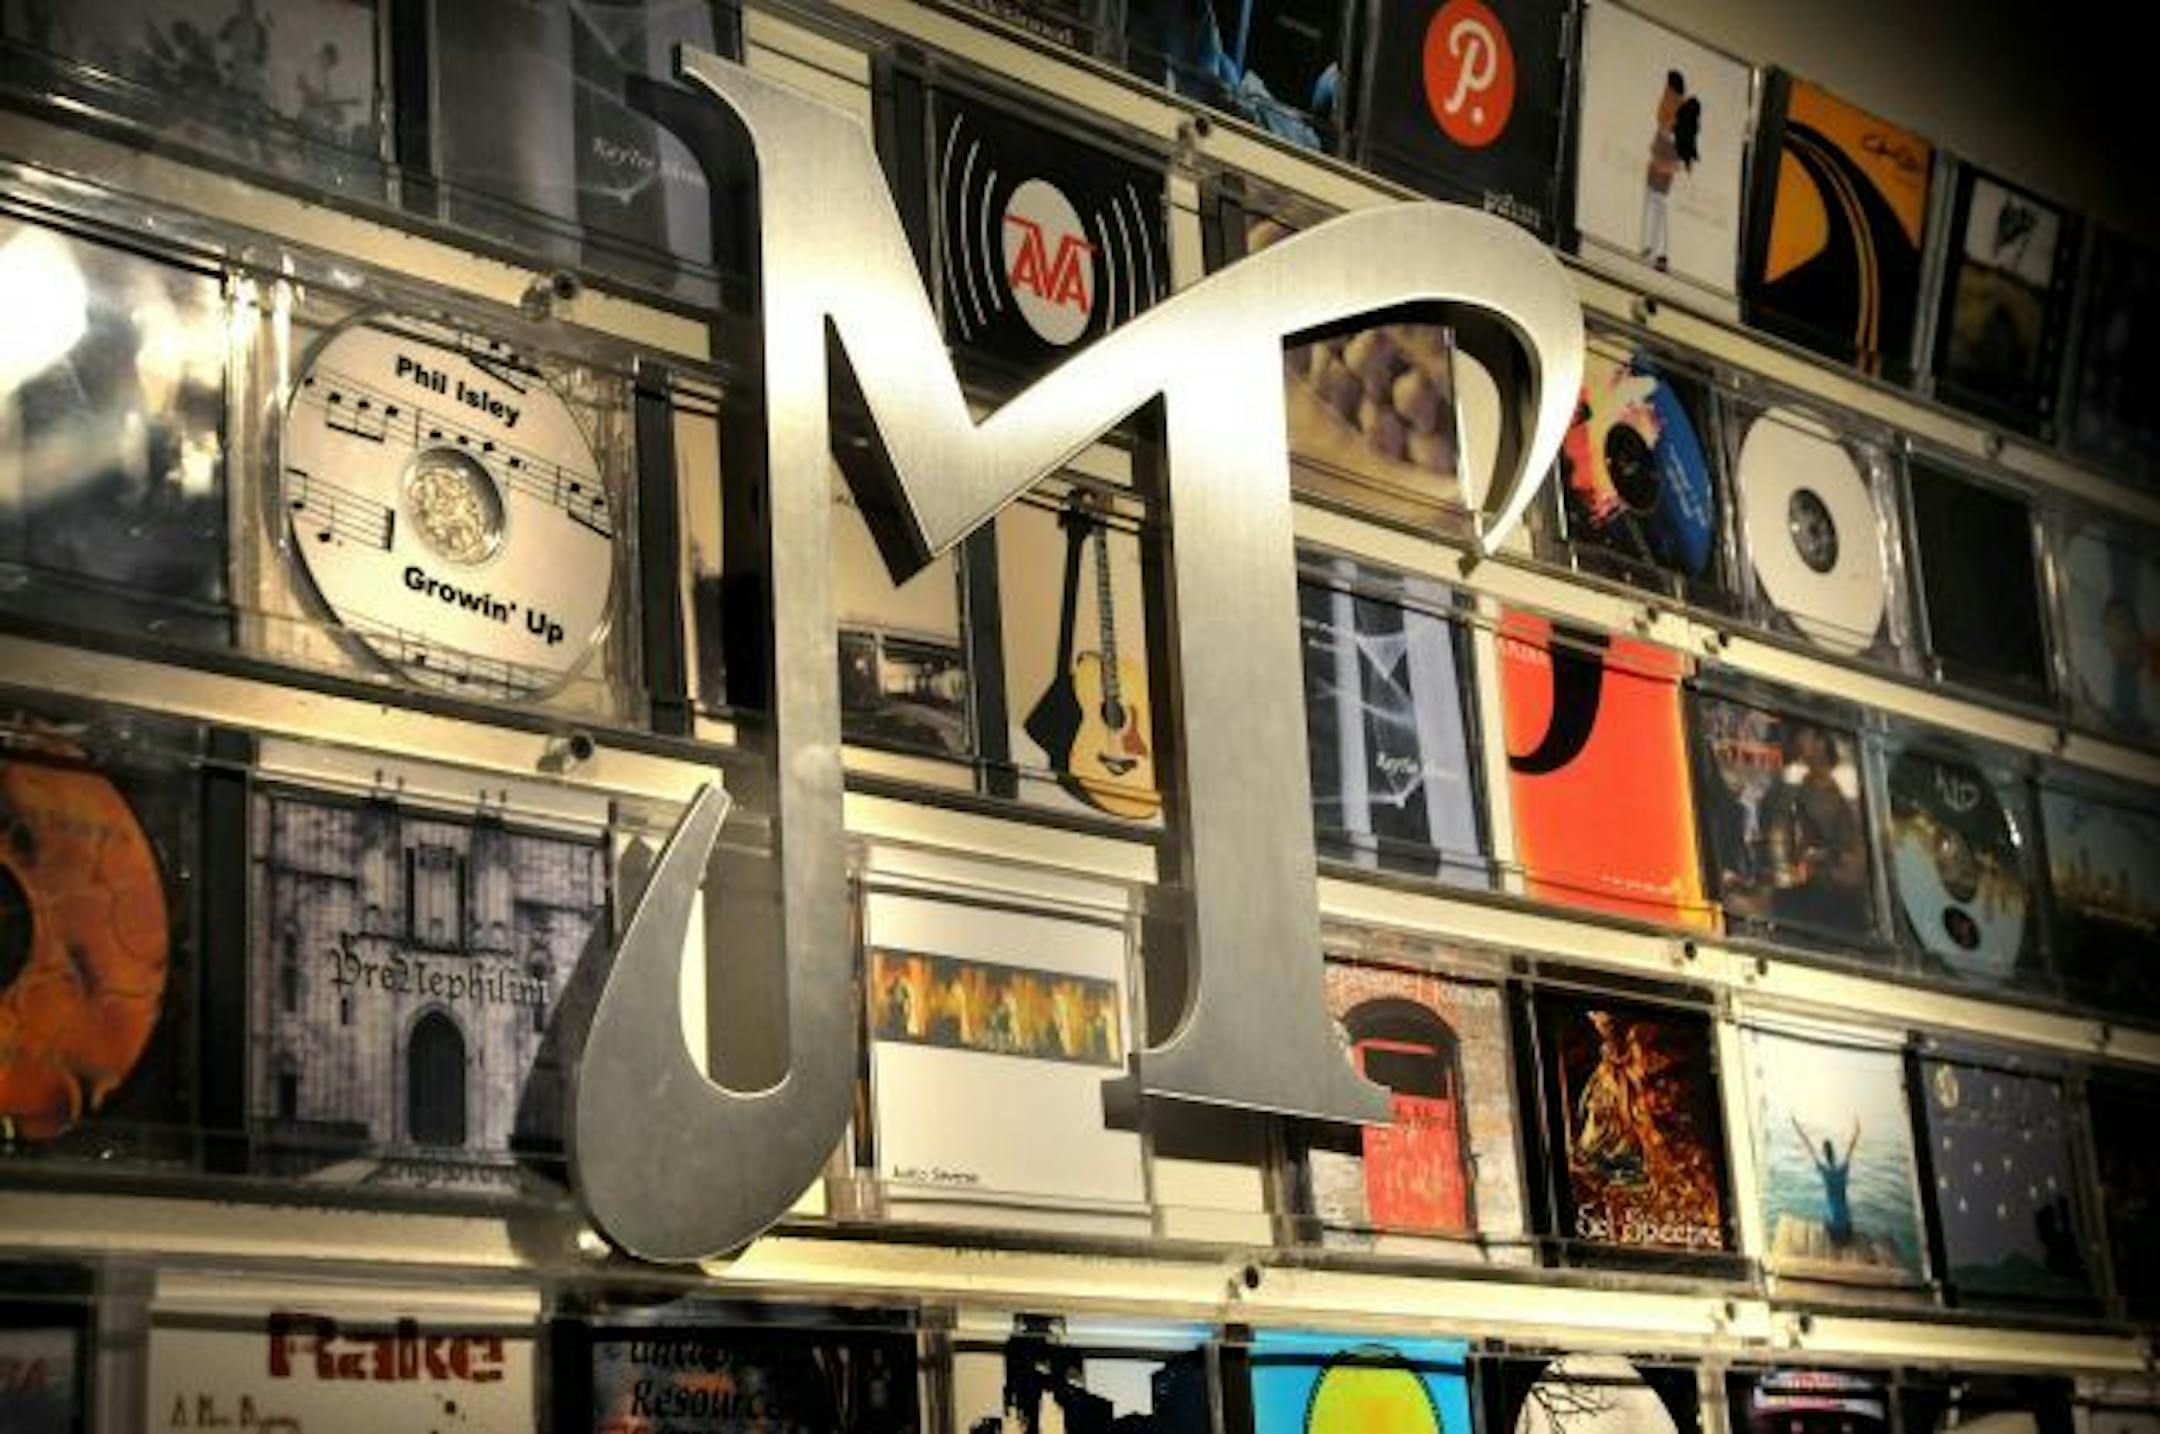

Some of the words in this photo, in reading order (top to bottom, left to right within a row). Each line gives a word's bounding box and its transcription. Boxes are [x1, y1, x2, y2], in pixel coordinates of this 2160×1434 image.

[1001, 214, 1097, 314] AVA
[395, 356, 448, 395] Phil
[455, 381, 520, 428] Isley
[403, 565, 517, 624] Growin'
[526, 608, 565, 645] Up
[269, 1312, 505, 1383] Rake
